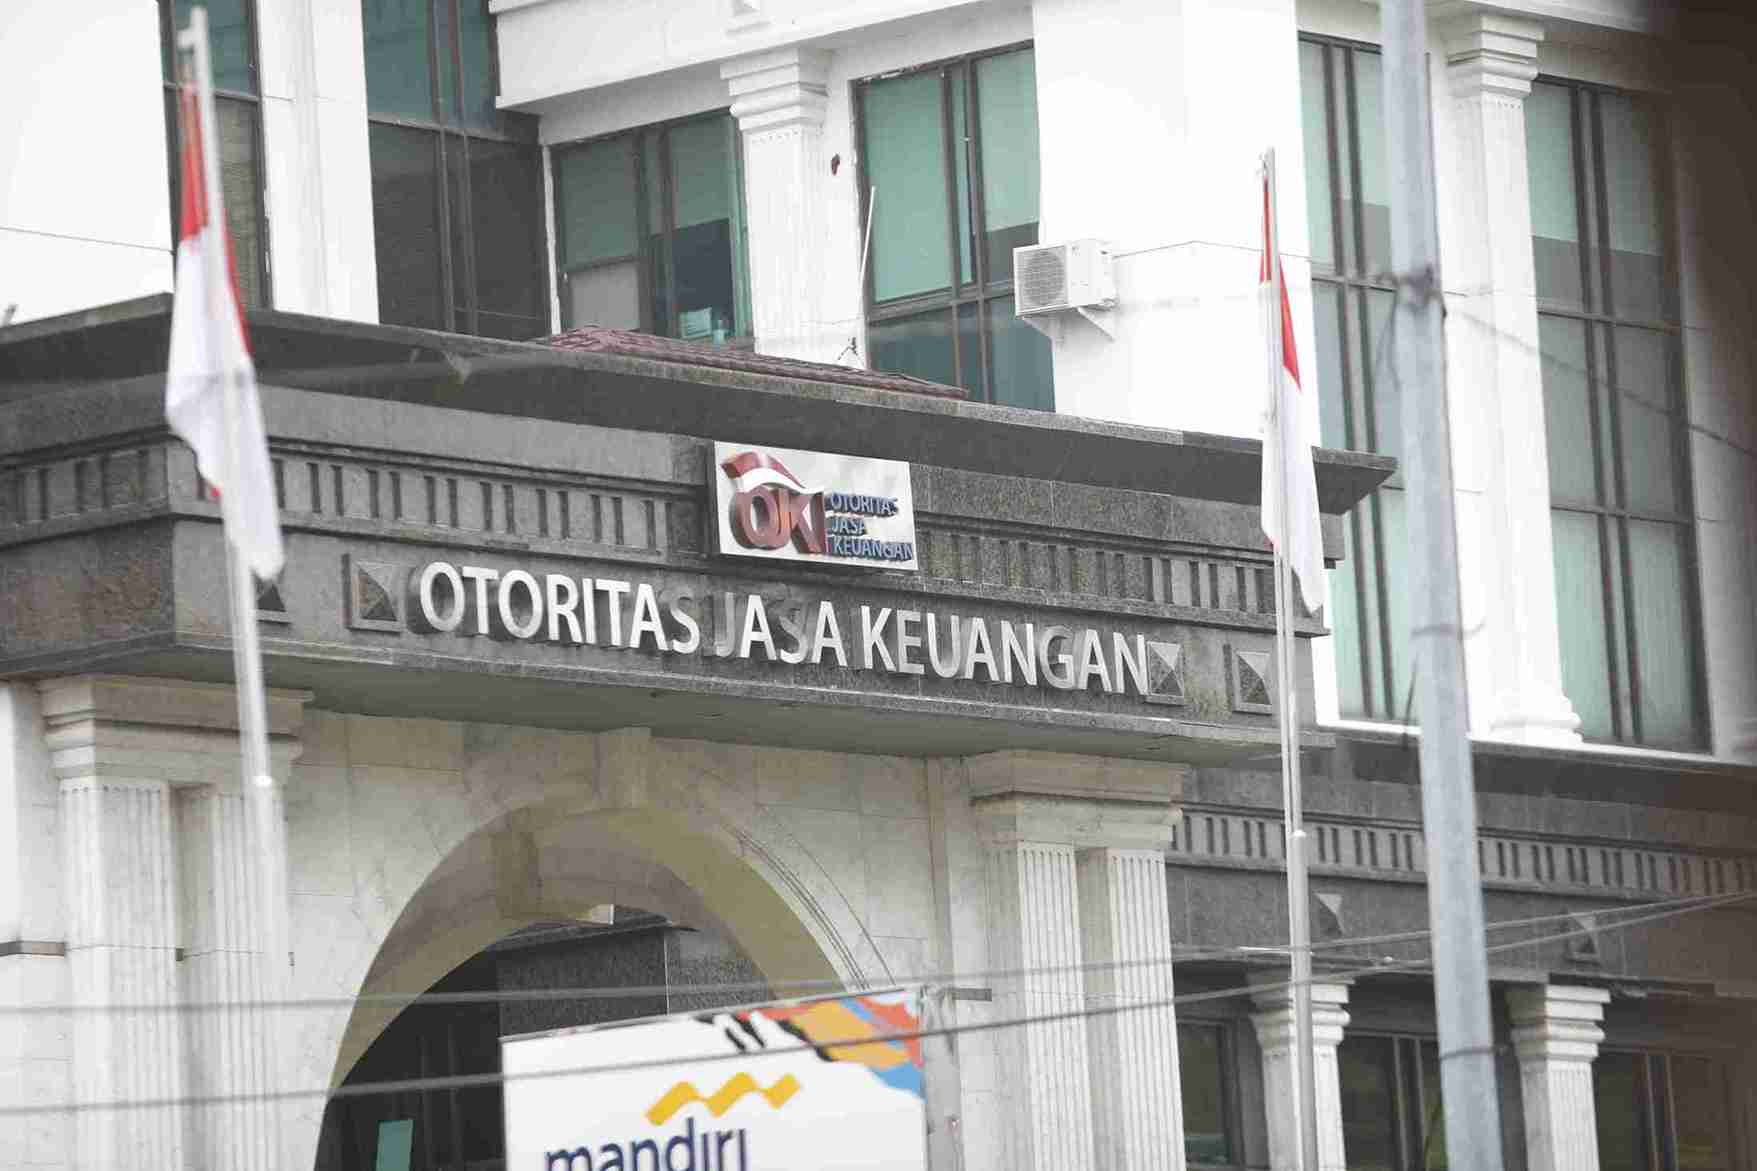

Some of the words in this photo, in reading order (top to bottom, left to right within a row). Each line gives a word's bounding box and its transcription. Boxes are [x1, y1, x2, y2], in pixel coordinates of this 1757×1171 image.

[831, 494, 899, 516] OTORITAS
[831, 516, 866, 535] JASA
[832, 536, 913, 561] KEUANGAN
[419, 561, 700, 655] OTORITAS
[715, 590, 848, 667] JASA
[860, 605, 1149, 696] KEUANGAN
